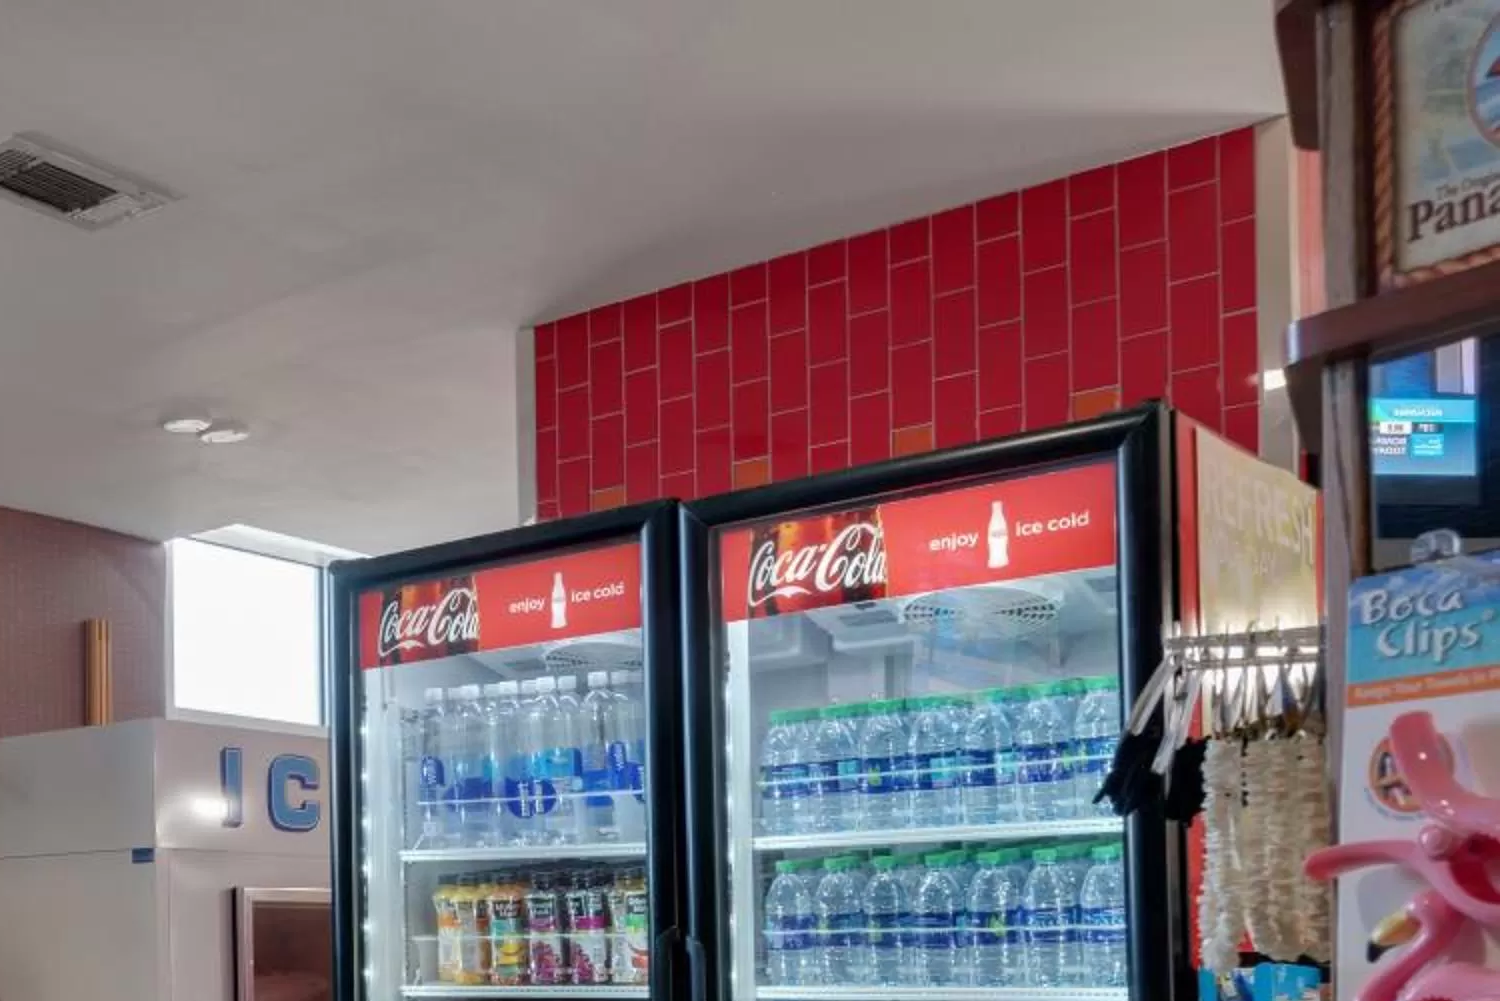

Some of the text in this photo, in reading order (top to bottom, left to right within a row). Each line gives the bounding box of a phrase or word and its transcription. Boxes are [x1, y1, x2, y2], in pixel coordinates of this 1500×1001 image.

[929, 510, 1090, 552] enjoy ice cold
[748, 523, 887, 607] Coca-Cola
[509, 582, 625, 615] enjoy ice cold
[1362, 588, 1463, 625] Boca
[379, 587, 479, 656] Coca-Cola
[1378, 620, 1481, 663] Clips
[221, 746, 320, 833] IC
